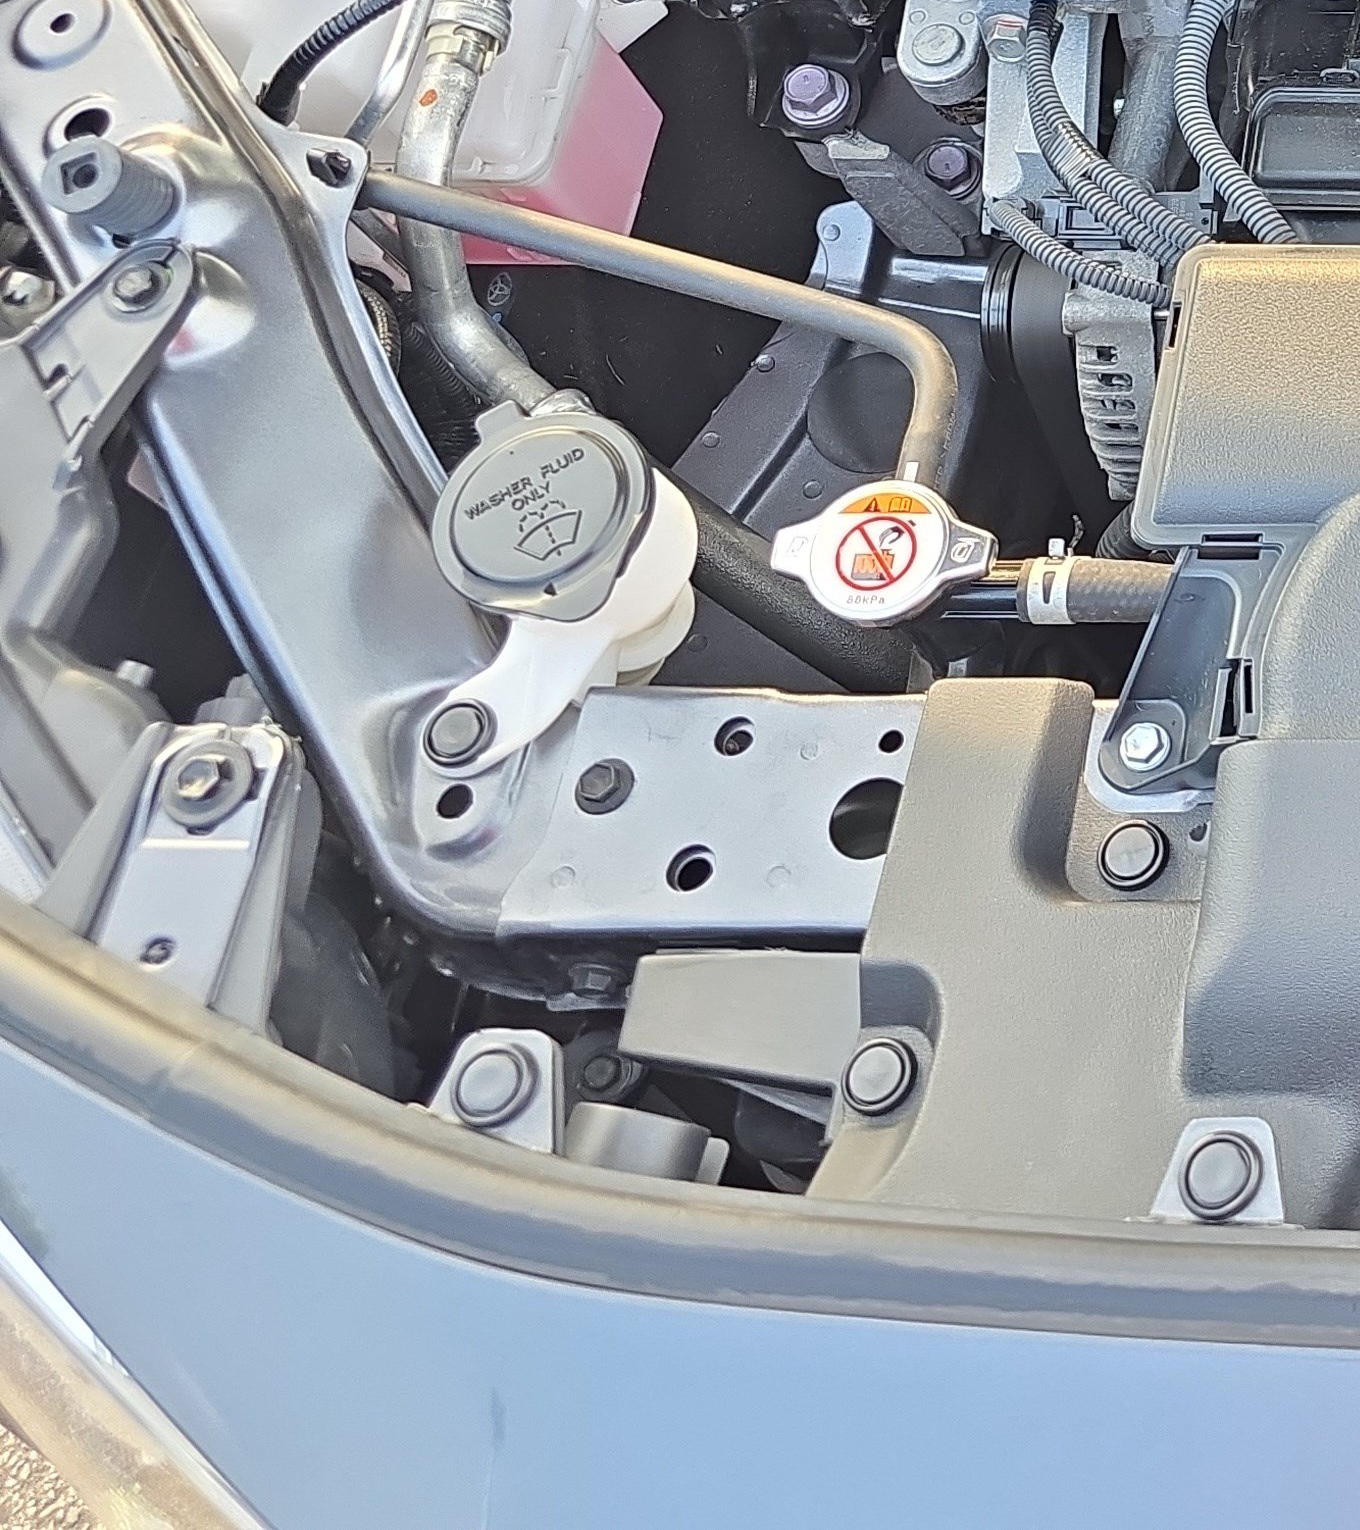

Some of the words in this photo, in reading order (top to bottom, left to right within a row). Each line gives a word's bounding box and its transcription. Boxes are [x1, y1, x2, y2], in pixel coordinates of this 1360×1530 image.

[465, 476, 533, 520] WASHER
[539, 447, 585, 479] FLUID
[512, 481, 551, 512] ONLY
